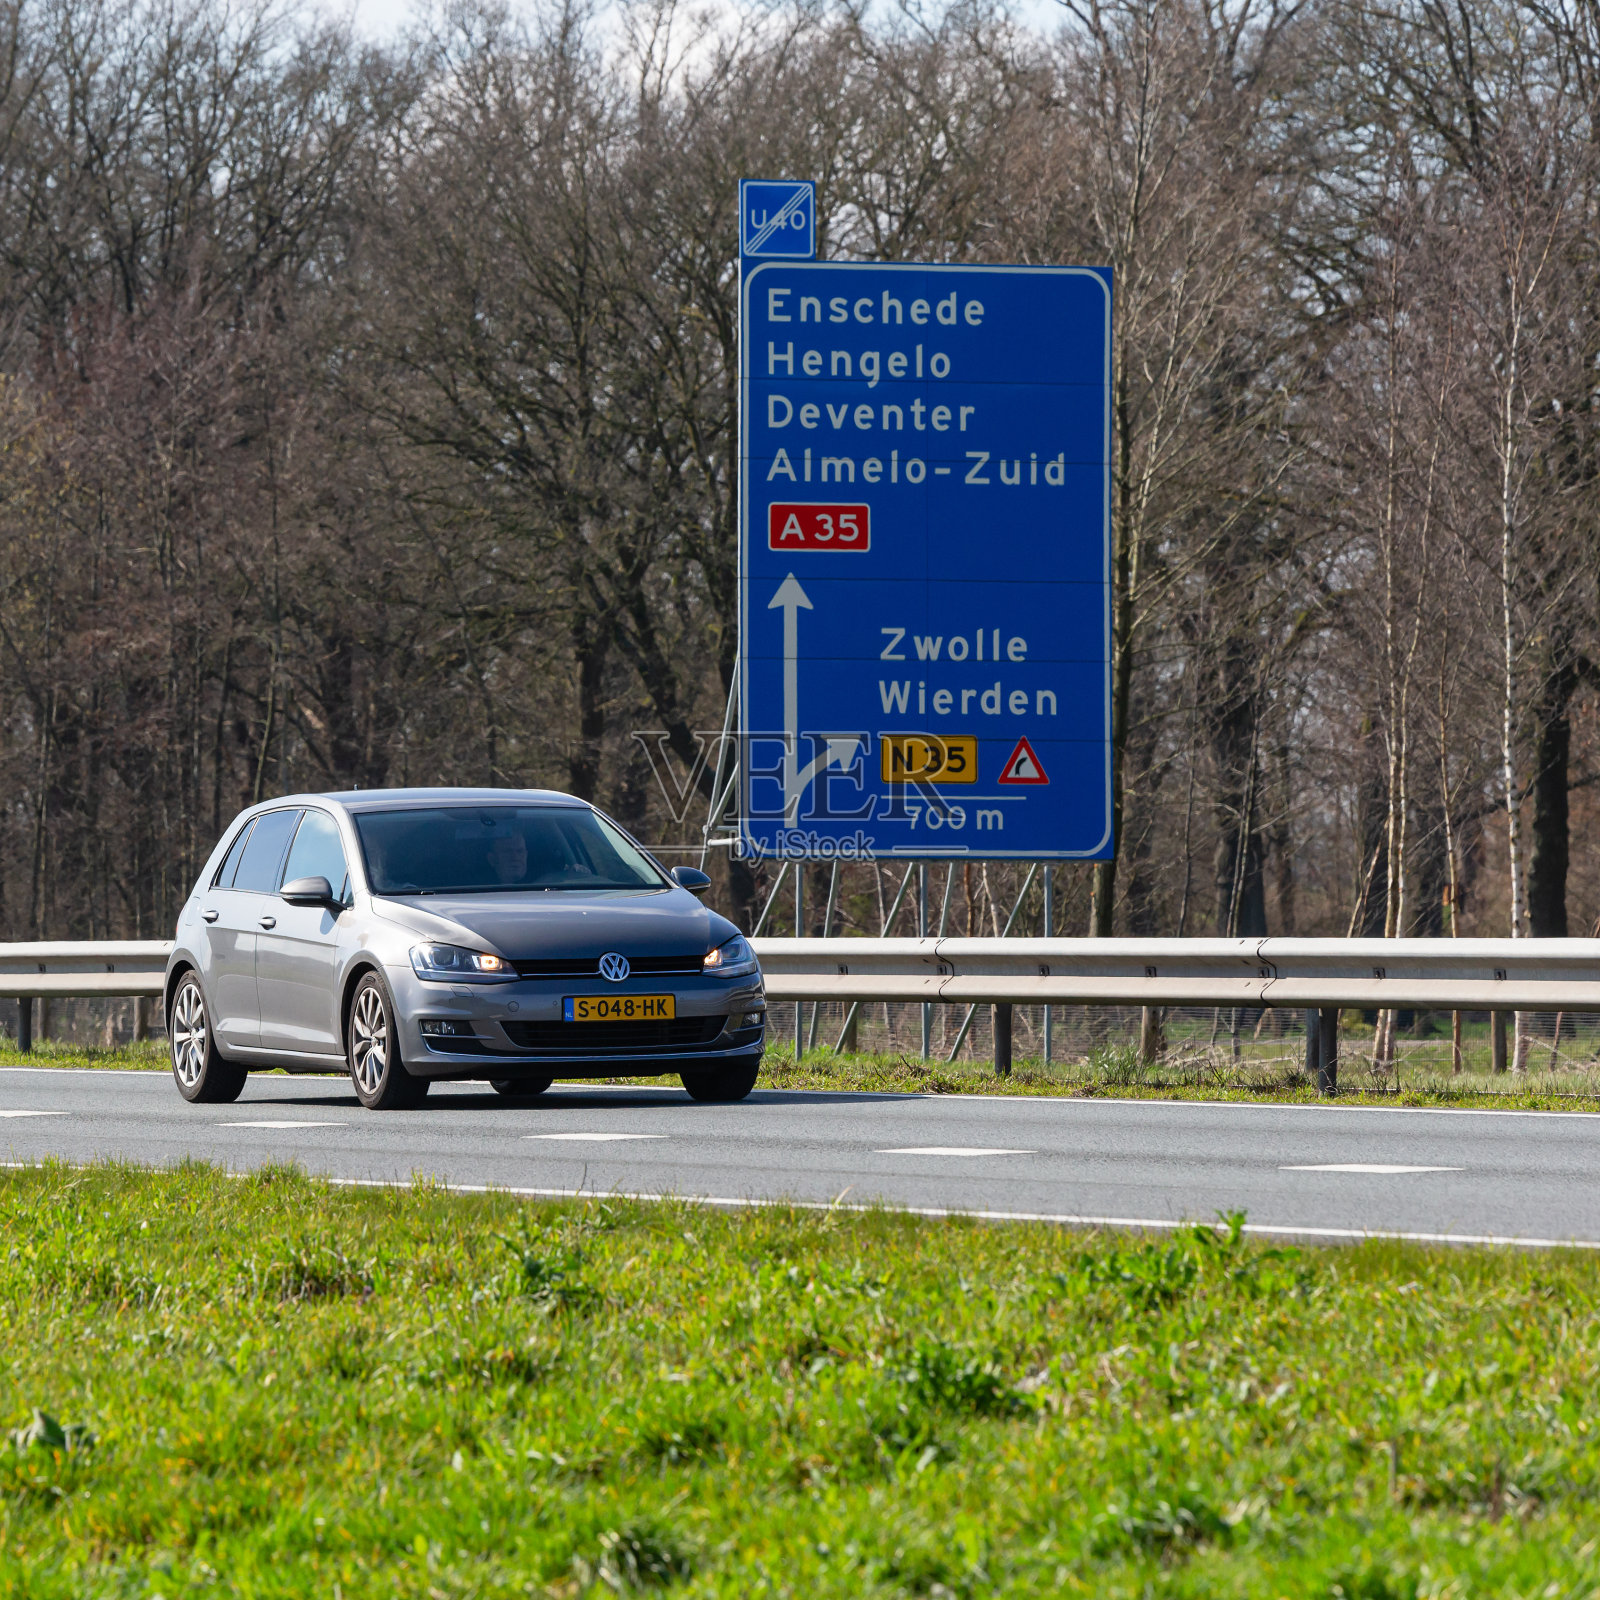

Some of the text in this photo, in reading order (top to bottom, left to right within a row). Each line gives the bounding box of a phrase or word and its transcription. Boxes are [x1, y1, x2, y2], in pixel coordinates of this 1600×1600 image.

[767, 288, 985, 326] Enschede
[767, 341, 951, 388] Hengelo
[767, 394, 975, 431] Deventer
[779, 513, 859, 541] A 35
[879, 627, 1028, 662] Zwolle
[879, 680, 1058, 716] Wierden
[907, 806, 1004, 831] 700 m
[578, 998, 668, 1018] S-048-HK
